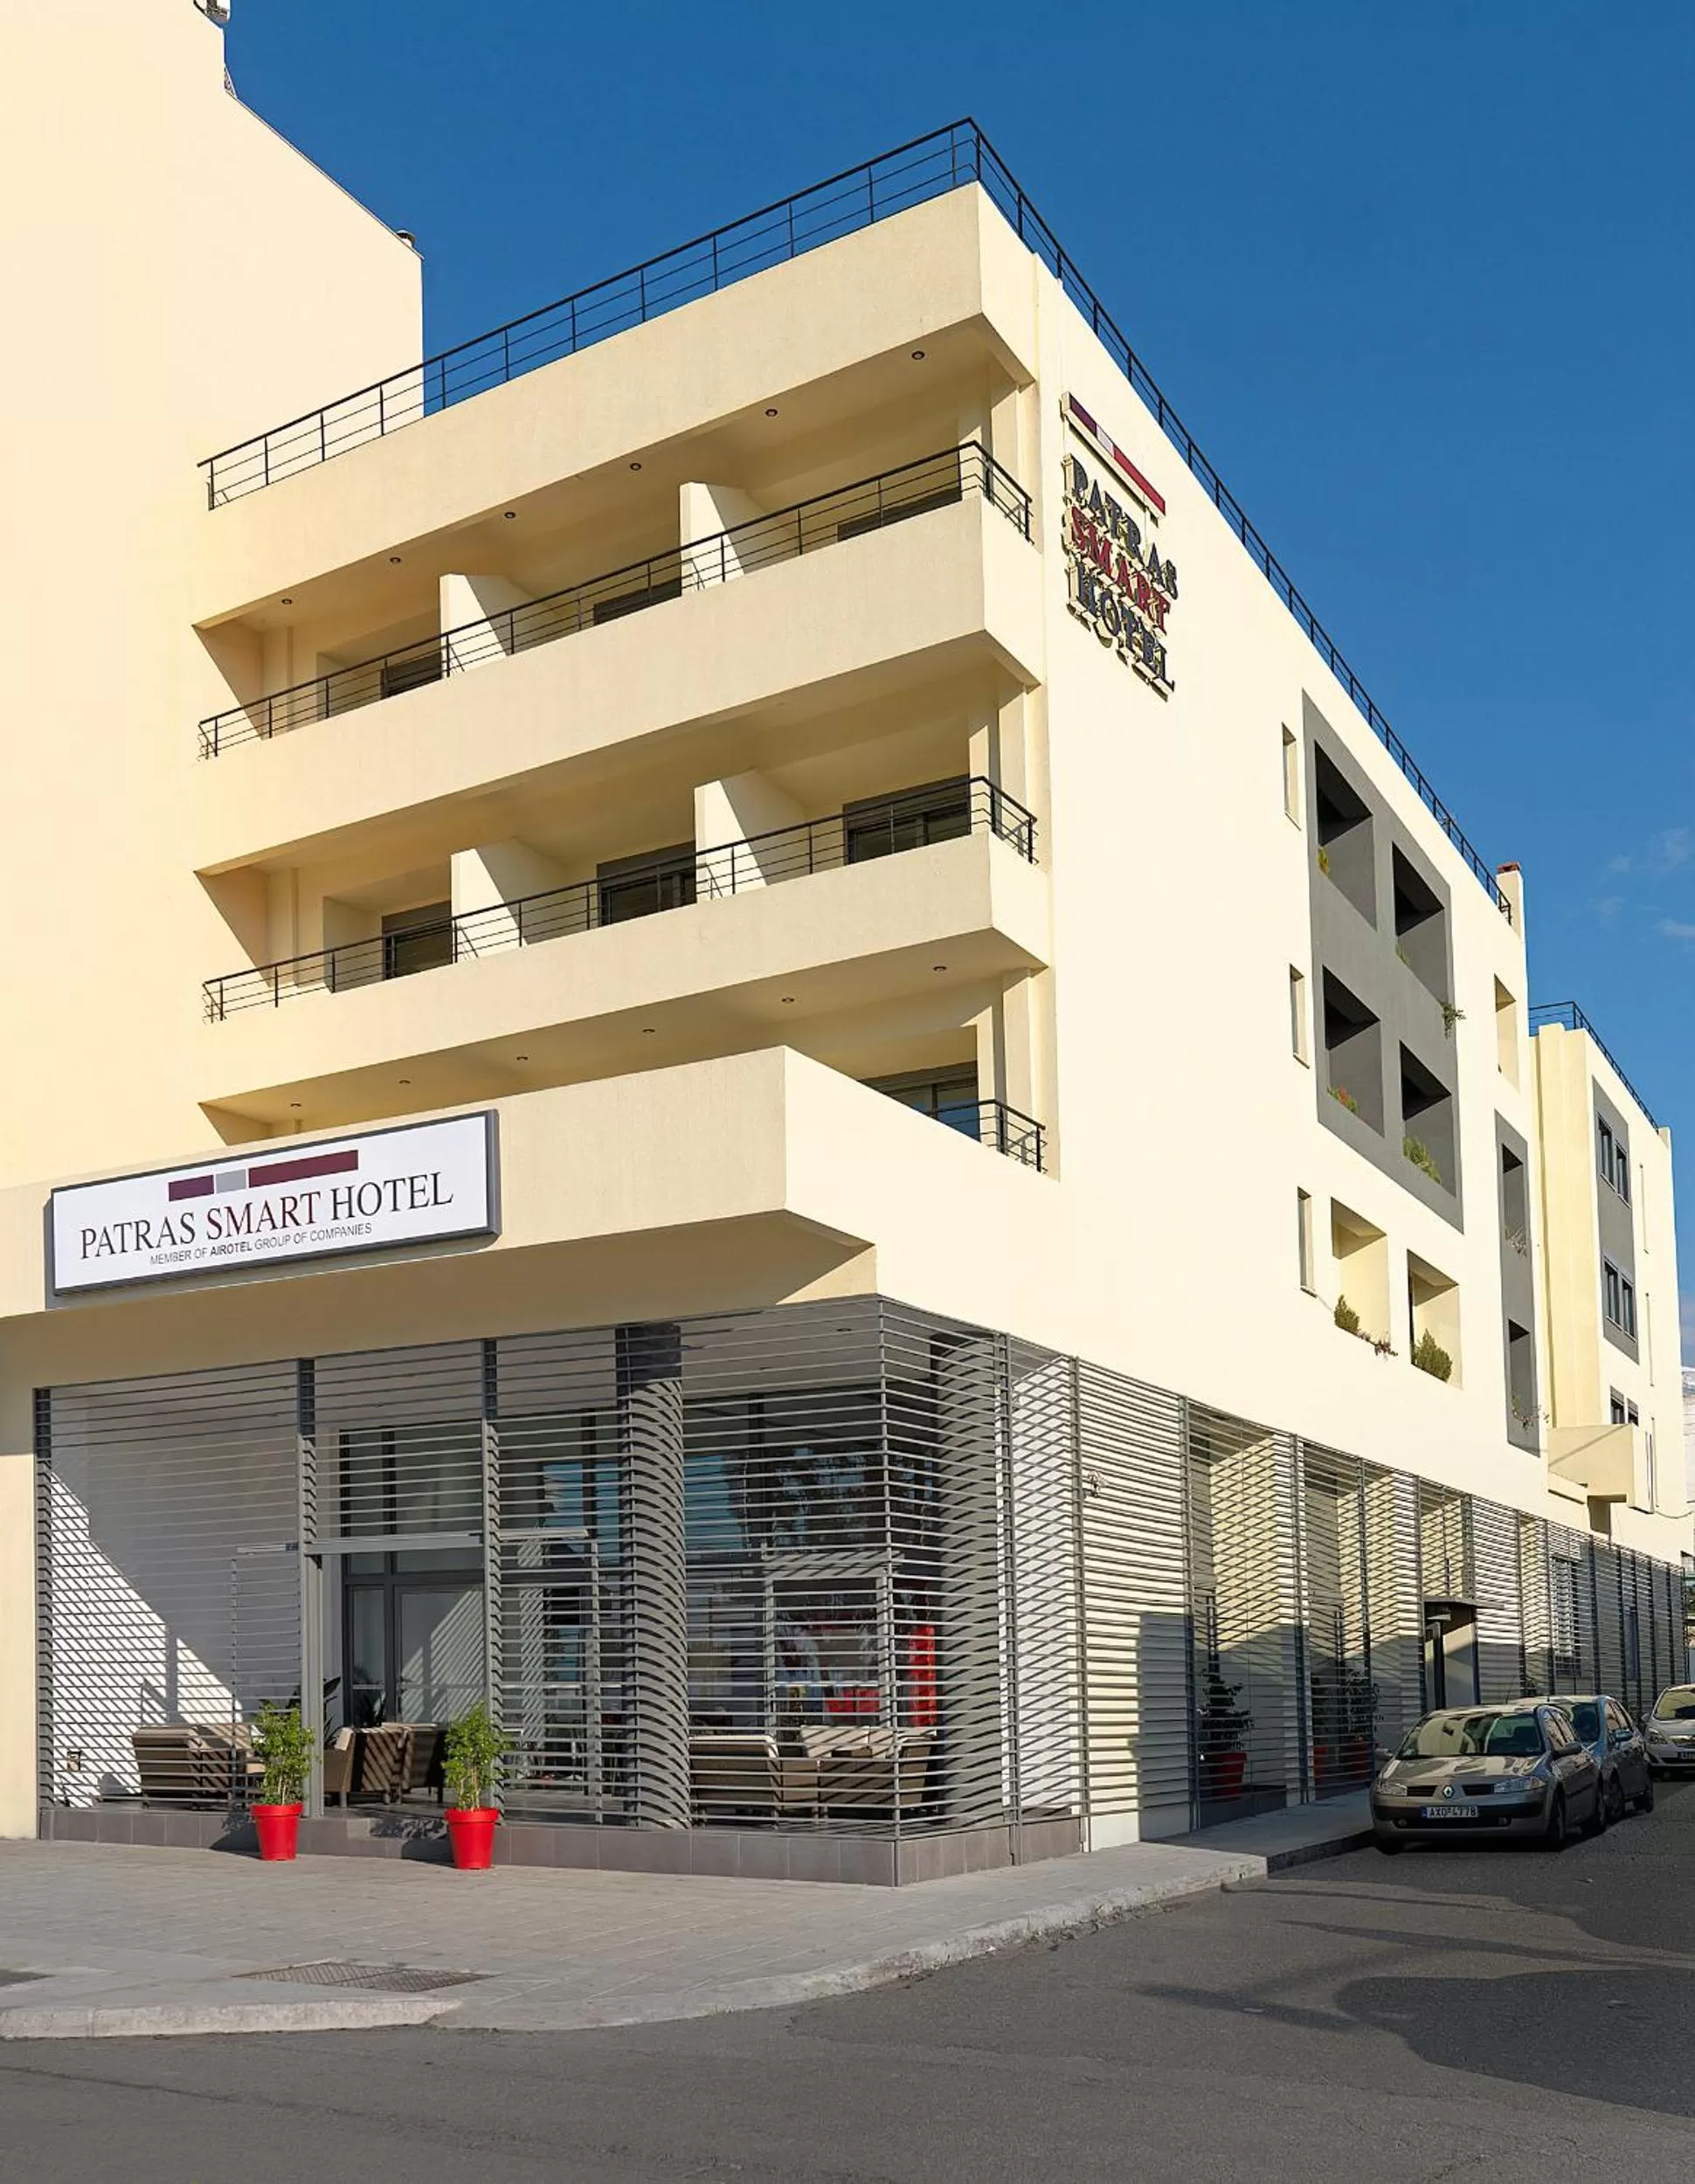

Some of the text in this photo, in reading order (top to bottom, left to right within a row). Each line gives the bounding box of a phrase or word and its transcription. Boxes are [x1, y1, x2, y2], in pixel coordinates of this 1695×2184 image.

[1063, 503, 1172, 635] SMART
[1064, 453, 1178, 600] PATRAS
[1068, 560, 1175, 693] HOTEL
[81, 1171, 454, 1259] PATRAS SMART HOTEL
[150, 1223, 372, 1265] MEMBER OF AIROTEL GROUP OF COMPANIES
